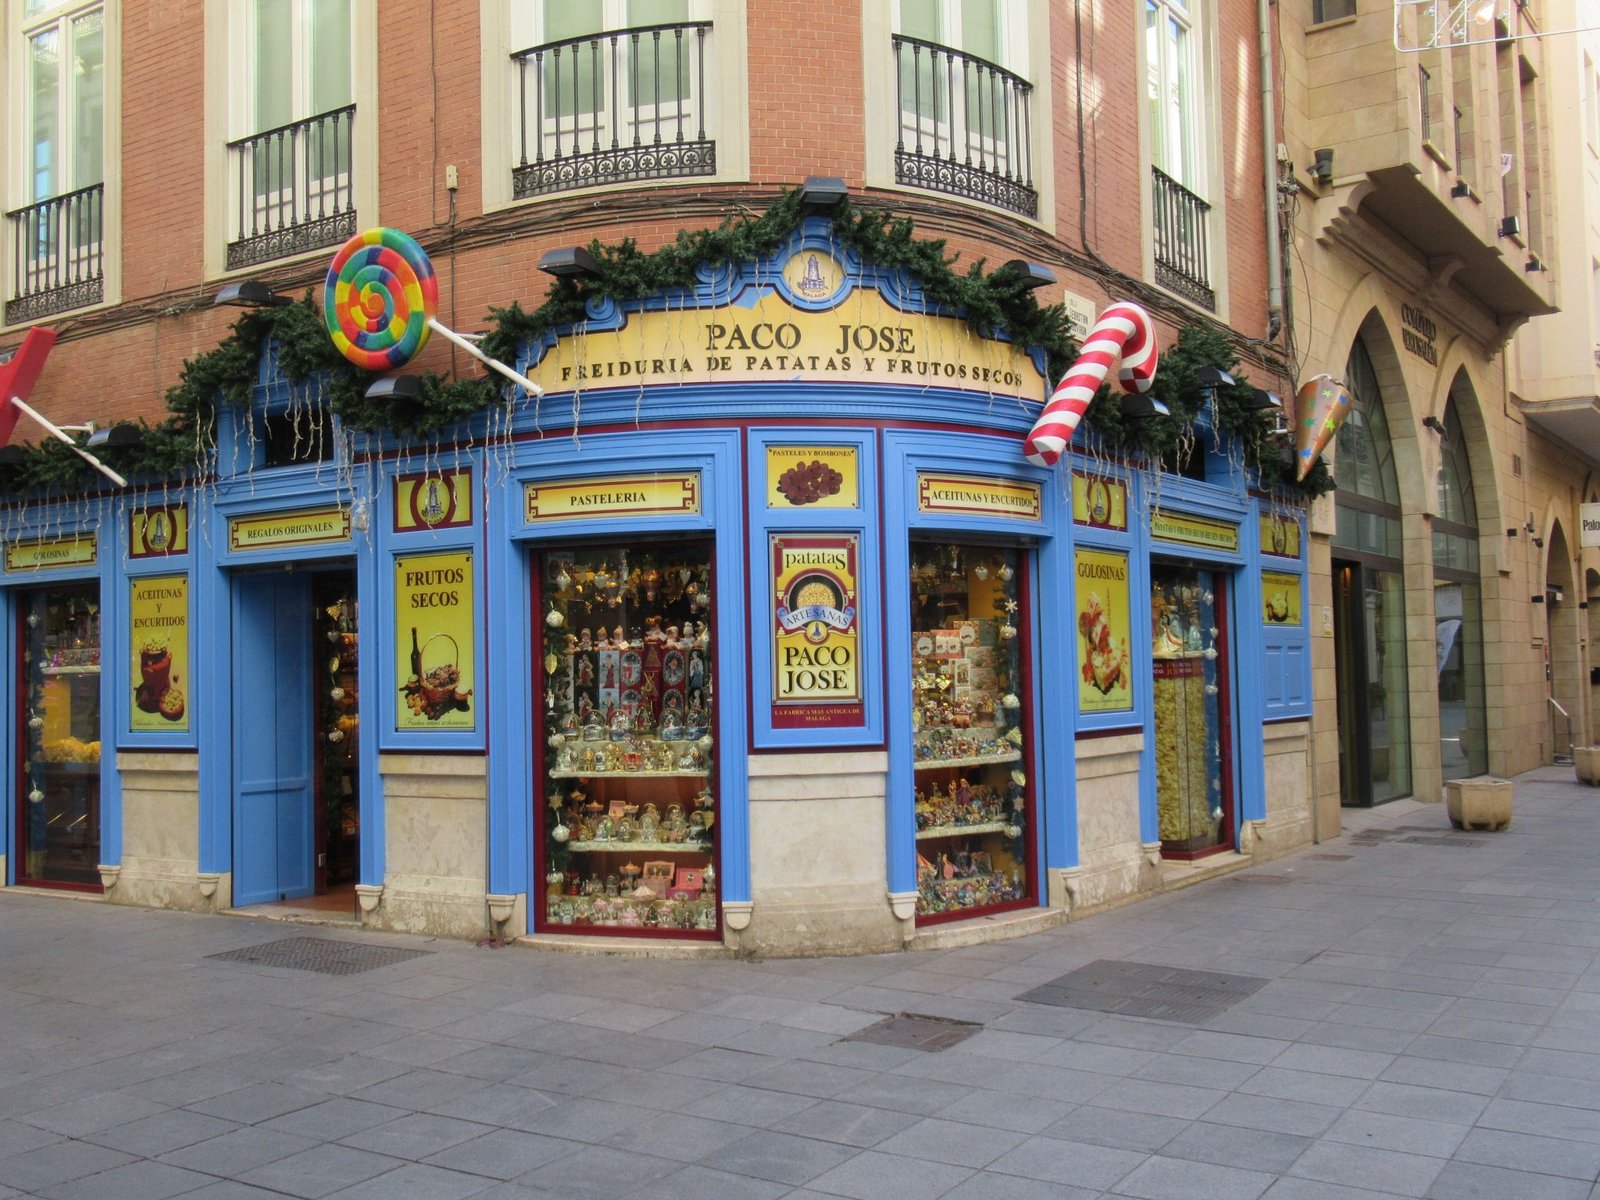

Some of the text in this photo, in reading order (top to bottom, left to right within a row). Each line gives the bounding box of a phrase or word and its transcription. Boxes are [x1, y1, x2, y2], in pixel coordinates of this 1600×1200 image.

[705, 323, 915, 355] PACO JOSE
[561, 355, 1023, 386] FREIDURIA DE PATATAS Y FRUTOS SECOS
[570, 492, 647, 506] PASTELERIA
[931, 490, 1033, 508] ACEITUNAS Y ENCURTIDOS
[247, 522, 333, 539] REGALOS ORIGINALES
[33, 549, 70, 560] GOLOSINAS
[406, 567, 464, 587] FRUTOS
[1078, 562, 1125, 581] GOLOSINAS
[136, 588, 182, 601] ACEITUNAS
[411, 590, 459, 609] SECOS
[156, 603, 162, 613] Y
[785, 607, 849, 627] ARTESANAS
[134, 615, 185, 628] ENCURTIDOS
[784, 645, 851, 667] PACO
[783, 669, 848, 694] JOSE
